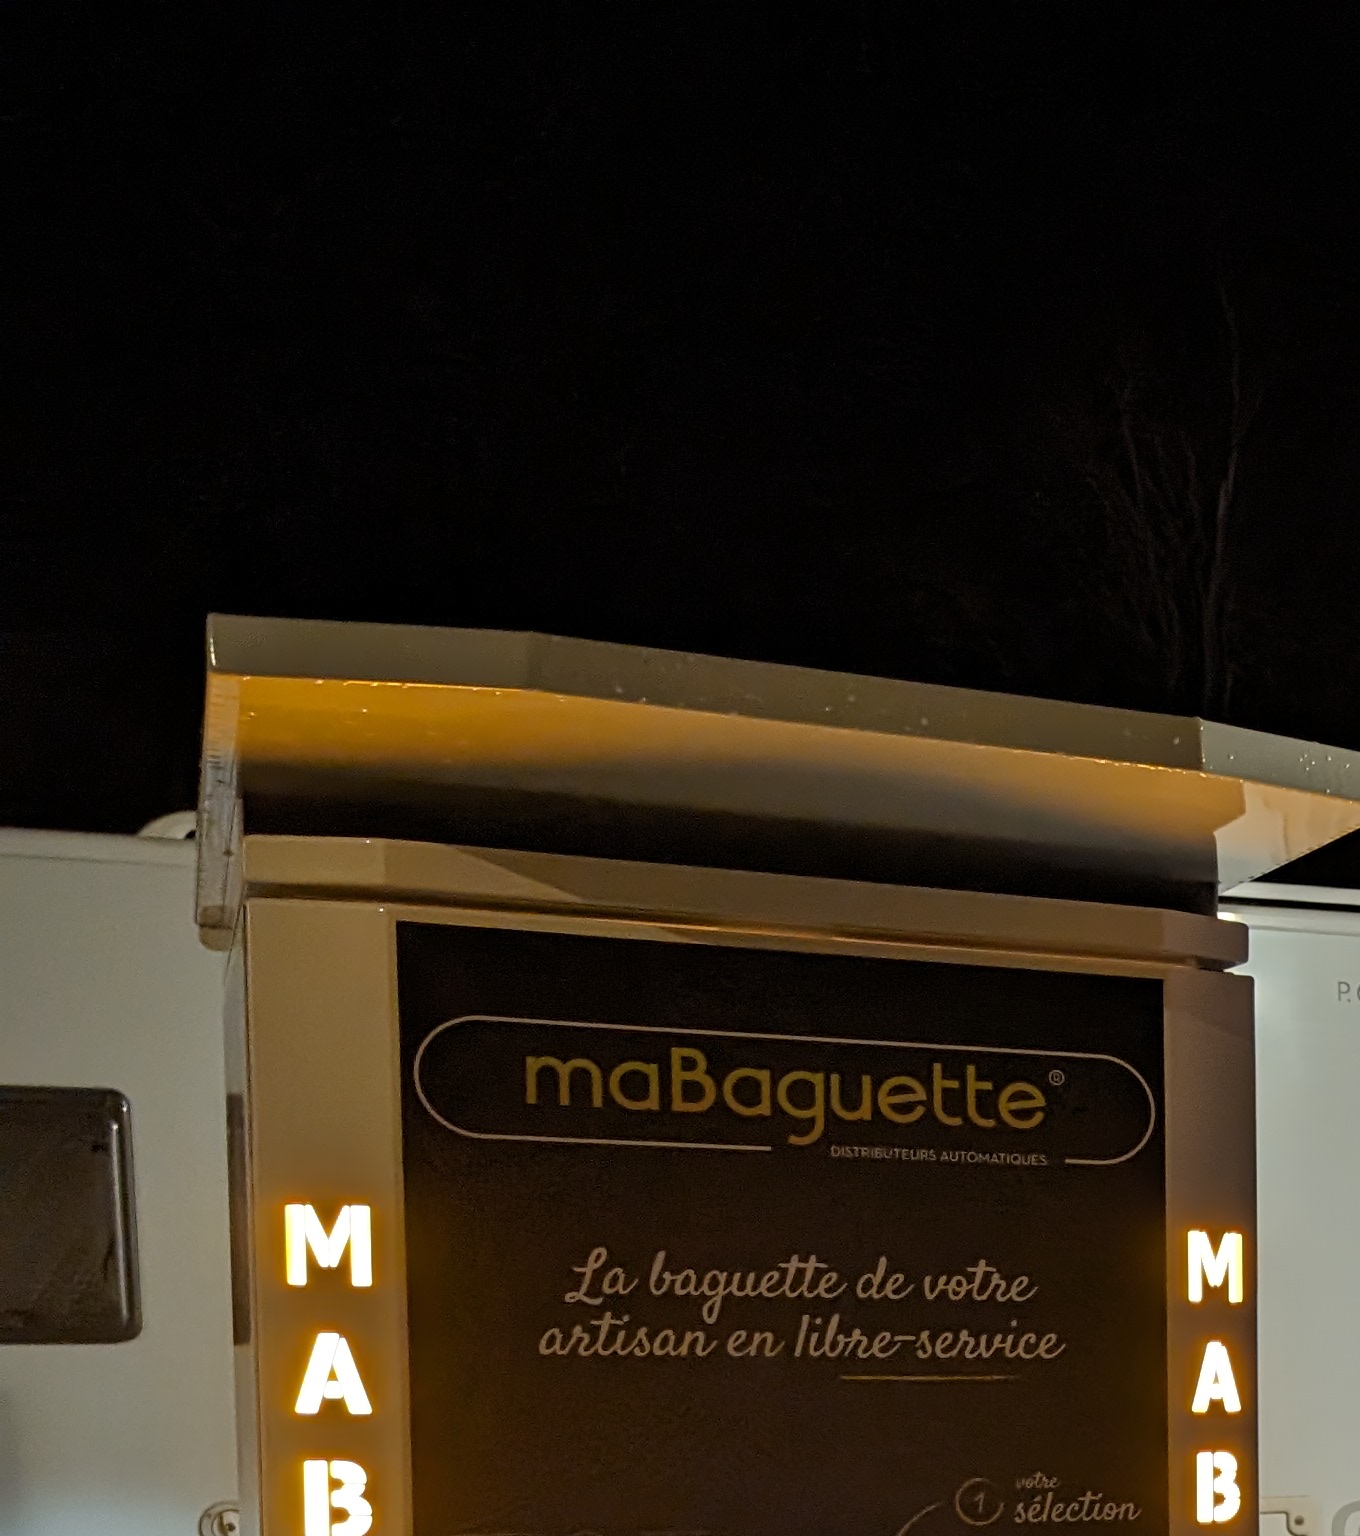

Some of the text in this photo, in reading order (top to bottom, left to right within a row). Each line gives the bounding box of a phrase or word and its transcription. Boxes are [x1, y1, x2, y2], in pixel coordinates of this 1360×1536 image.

[830, 1145, 1048, 1166] DISTRIBUTEURS AUTOMATIQUES
[565, 1246, 1036, 1324] La baguette de votre
[539, 1314, 1066, 1362] artisan en libre-service
[1015, 1470, 1060, 1489] votre
[1013, 1490, 1143, 1524] sélection
